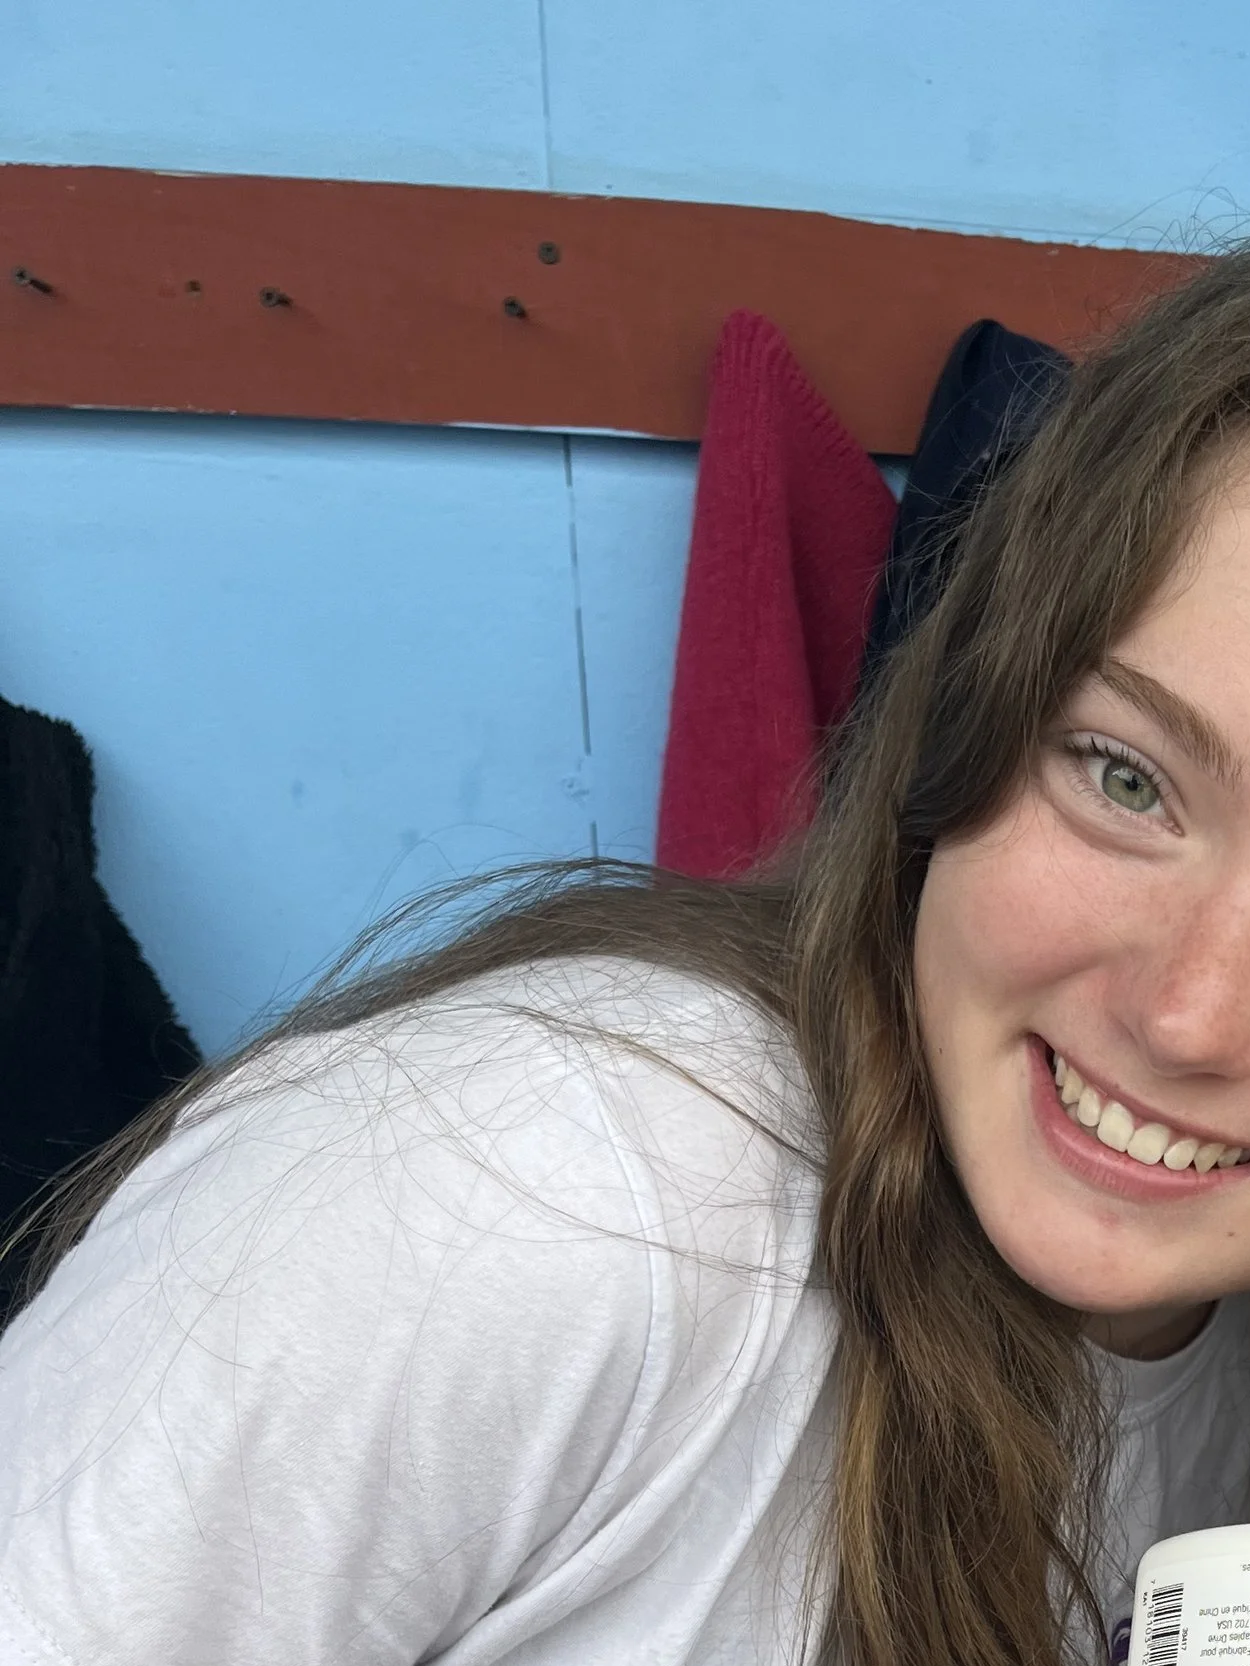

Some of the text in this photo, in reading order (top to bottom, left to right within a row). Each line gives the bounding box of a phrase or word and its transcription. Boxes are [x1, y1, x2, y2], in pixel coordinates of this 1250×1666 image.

[1199, 1608, 1219, 1617] Chine
[1221, 1607, 1230, 1615] en
[1217, 1620, 1232, 1629] USA
[1208, 1634, 1227, 1643] Drive
[1200, 1648, 1217, 1657] pour
